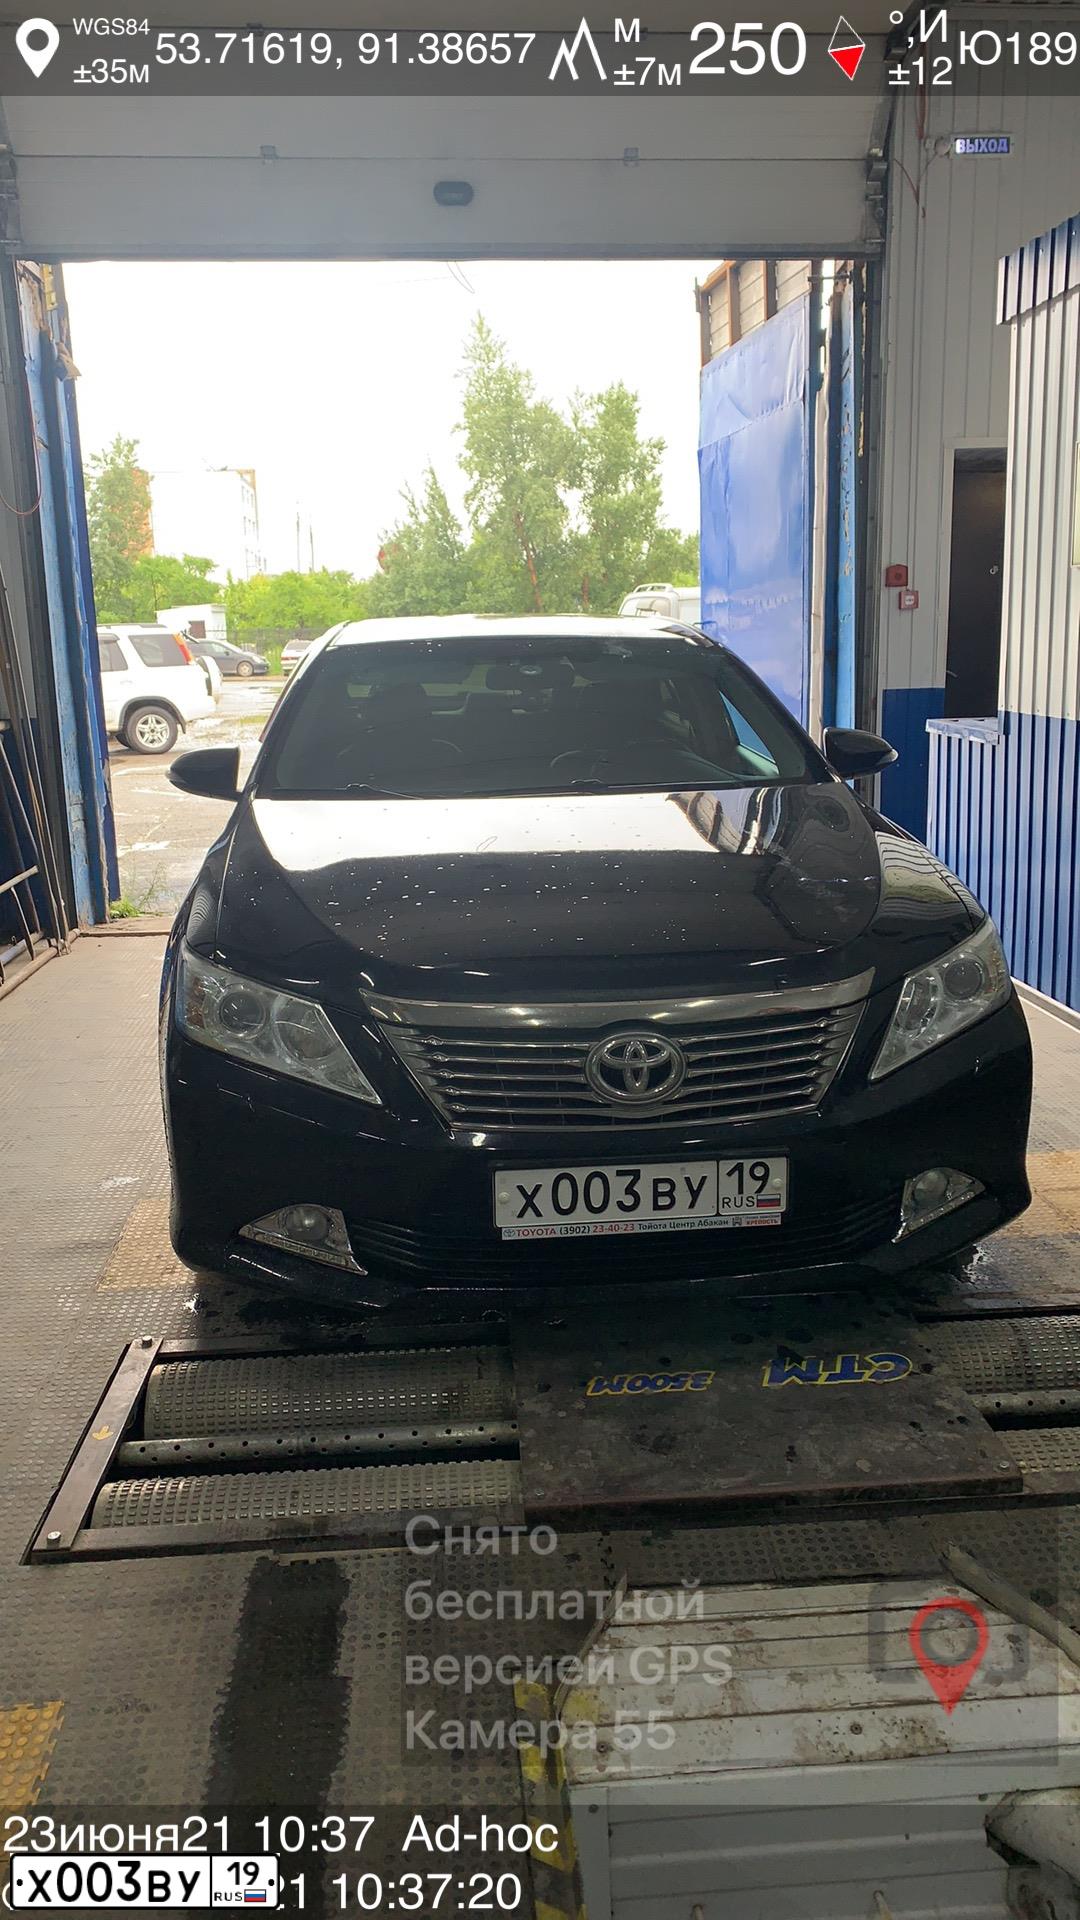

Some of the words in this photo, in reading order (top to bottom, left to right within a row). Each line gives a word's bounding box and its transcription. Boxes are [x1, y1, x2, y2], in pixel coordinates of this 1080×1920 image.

[955, 138, 1008, 153] ВЫХОД
[726, 1161, 771, 1196] 19
[721, 1196, 755, 1208] RUS
[516, 1228, 556, 1237] TOYOTA
[559, 1225, 590, 1235] (3902)
[592, 1223, 635, 1233] 23-40-23
[638, 1221, 667, 1230] Тойота
[669, 1220, 696, 1230] Центр
[698, 1218, 729, 1227] Абакан
